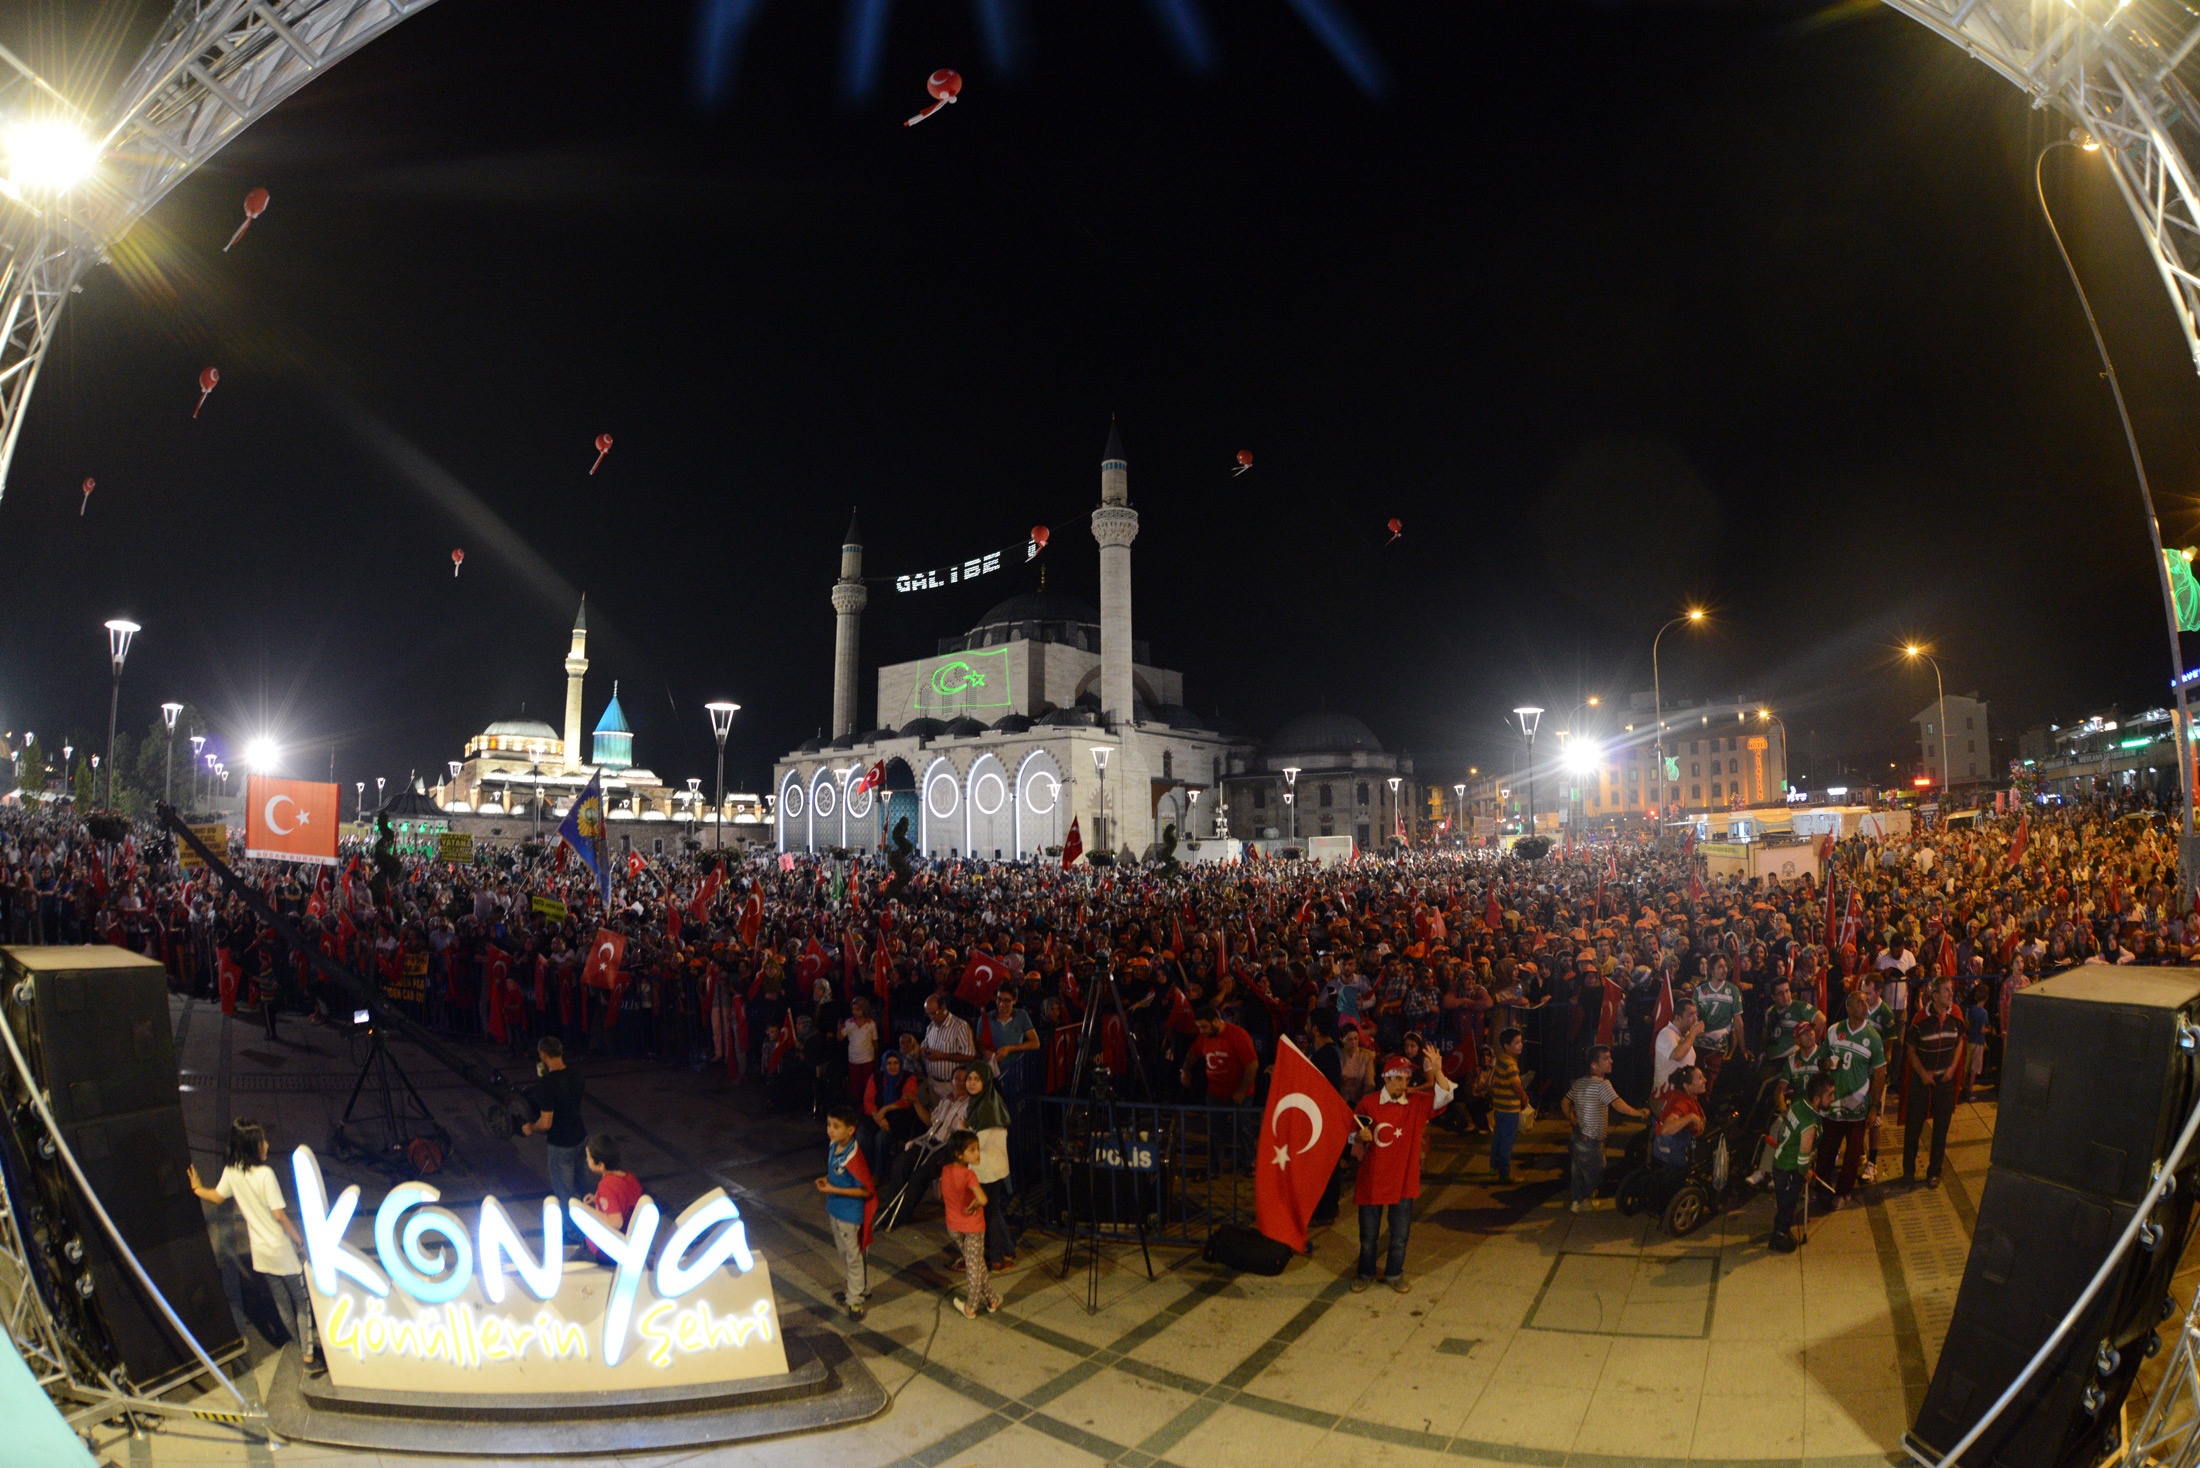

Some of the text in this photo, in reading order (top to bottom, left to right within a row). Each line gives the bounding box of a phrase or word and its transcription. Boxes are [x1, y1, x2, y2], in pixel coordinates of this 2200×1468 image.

[1710, 1001, 1720, 1017] 7
[1842, 1051, 1853, 1070] 9
[326, 1294, 772, 1368] Gönüllerin Şehri
